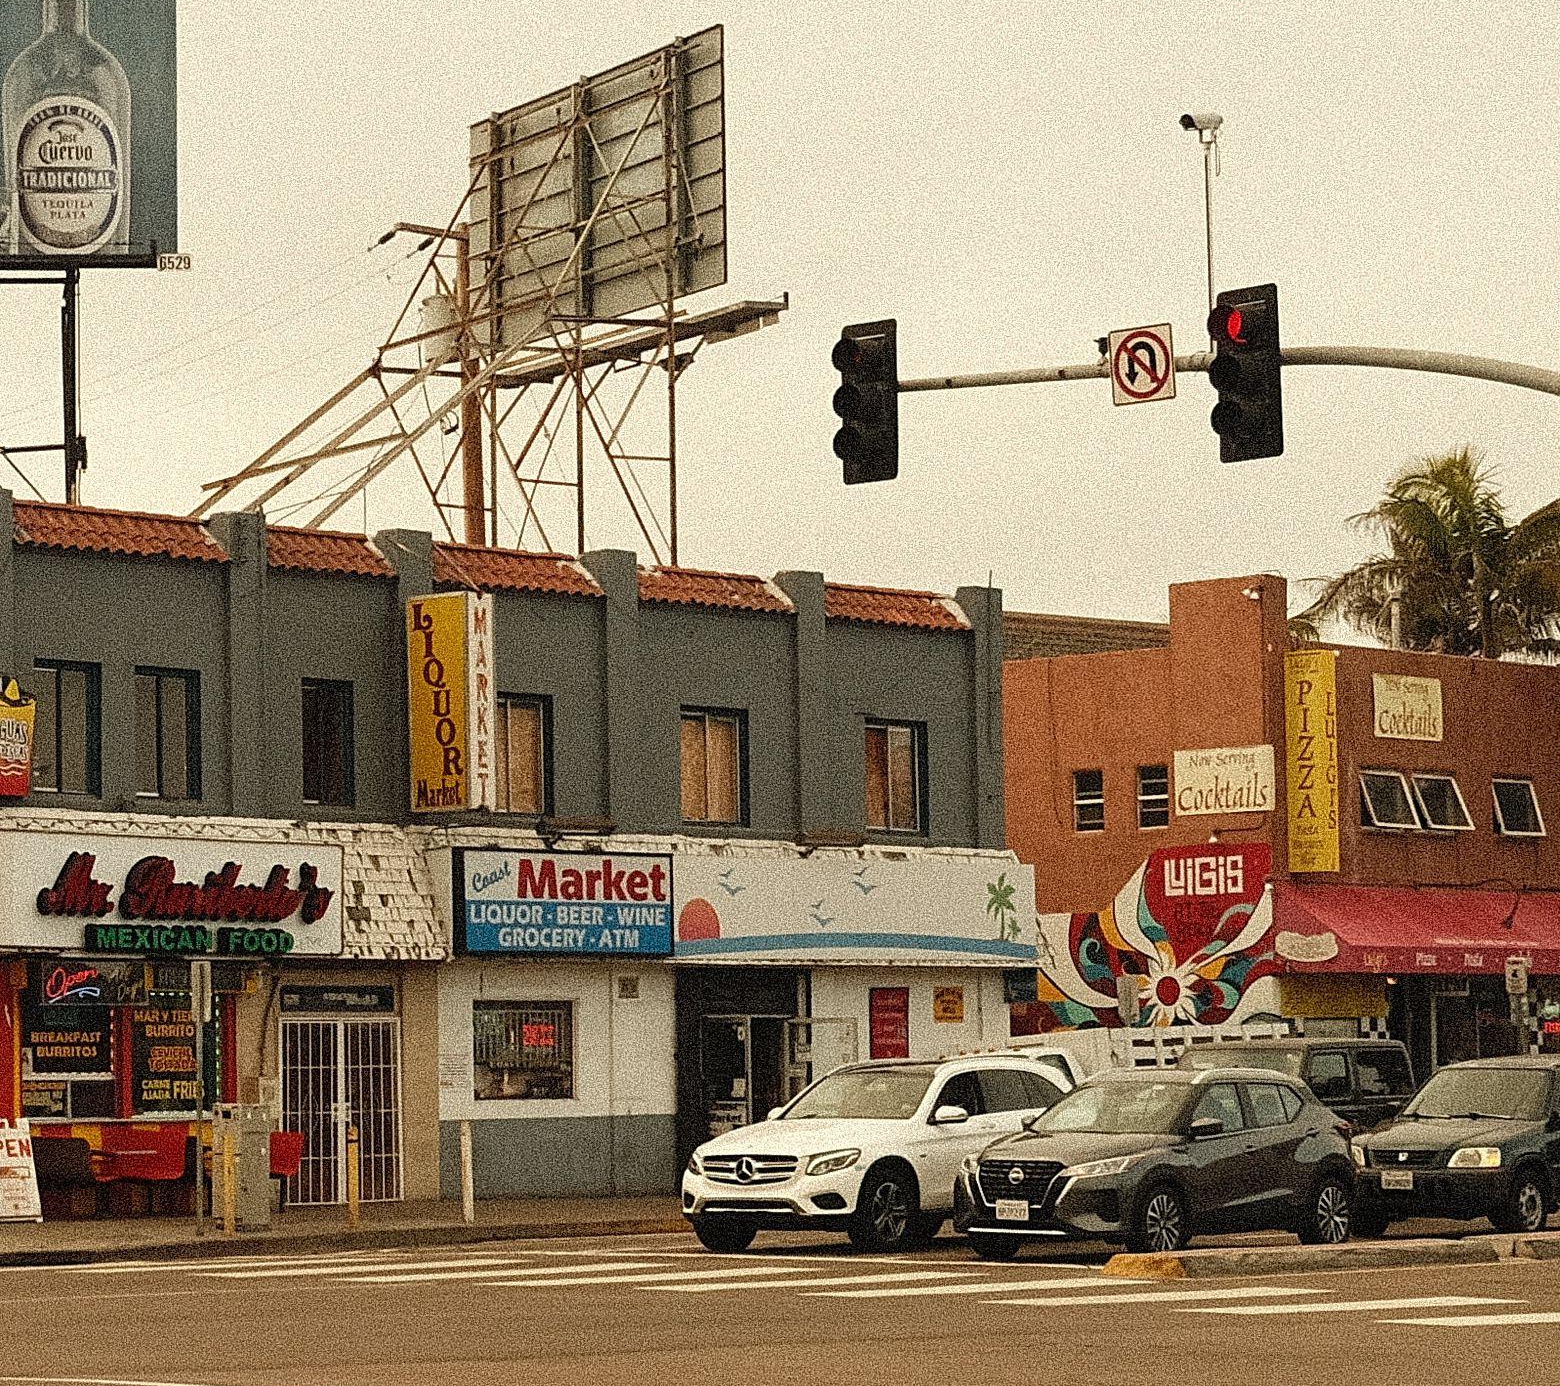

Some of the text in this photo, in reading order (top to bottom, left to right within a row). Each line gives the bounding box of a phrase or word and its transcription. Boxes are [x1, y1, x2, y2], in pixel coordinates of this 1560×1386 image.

[38, 139, 94, 164] Cuervo
[22, 170, 112, 188] TRADICIONAL
[41, 199, 94, 208] TEQUILA
[158, 255, 191, 270] 6529
[411, 603, 464, 776] LIQUOR
[474, 607, 489, 806] MARKET
[1378, 700, 1440, 739] Cocktails
[1189, 752, 1256, 771] Now Serving
[1295, 680, 1317, 819] PIZZA
[415, 778, 463, 809] Market
[1178, 772, 1269, 812] Cocktails
[471, 859, 666, 902] Coast Market
[471, 904, 666, 927] LIQUOR BEER WINE
[97, 928, 295, 953] MEXICAN FOOD
[498, 927, 640, 949] GROCERY ATM
[46, 966, 100, 998] Open
[30, 1031, 102, 1043] BREAKFAST
[145, 1024, 195, 1038] BURRITO
[36, 1046, 98, 1058] BURRITOS
[142, 1079, 171, 1090] CARNE
